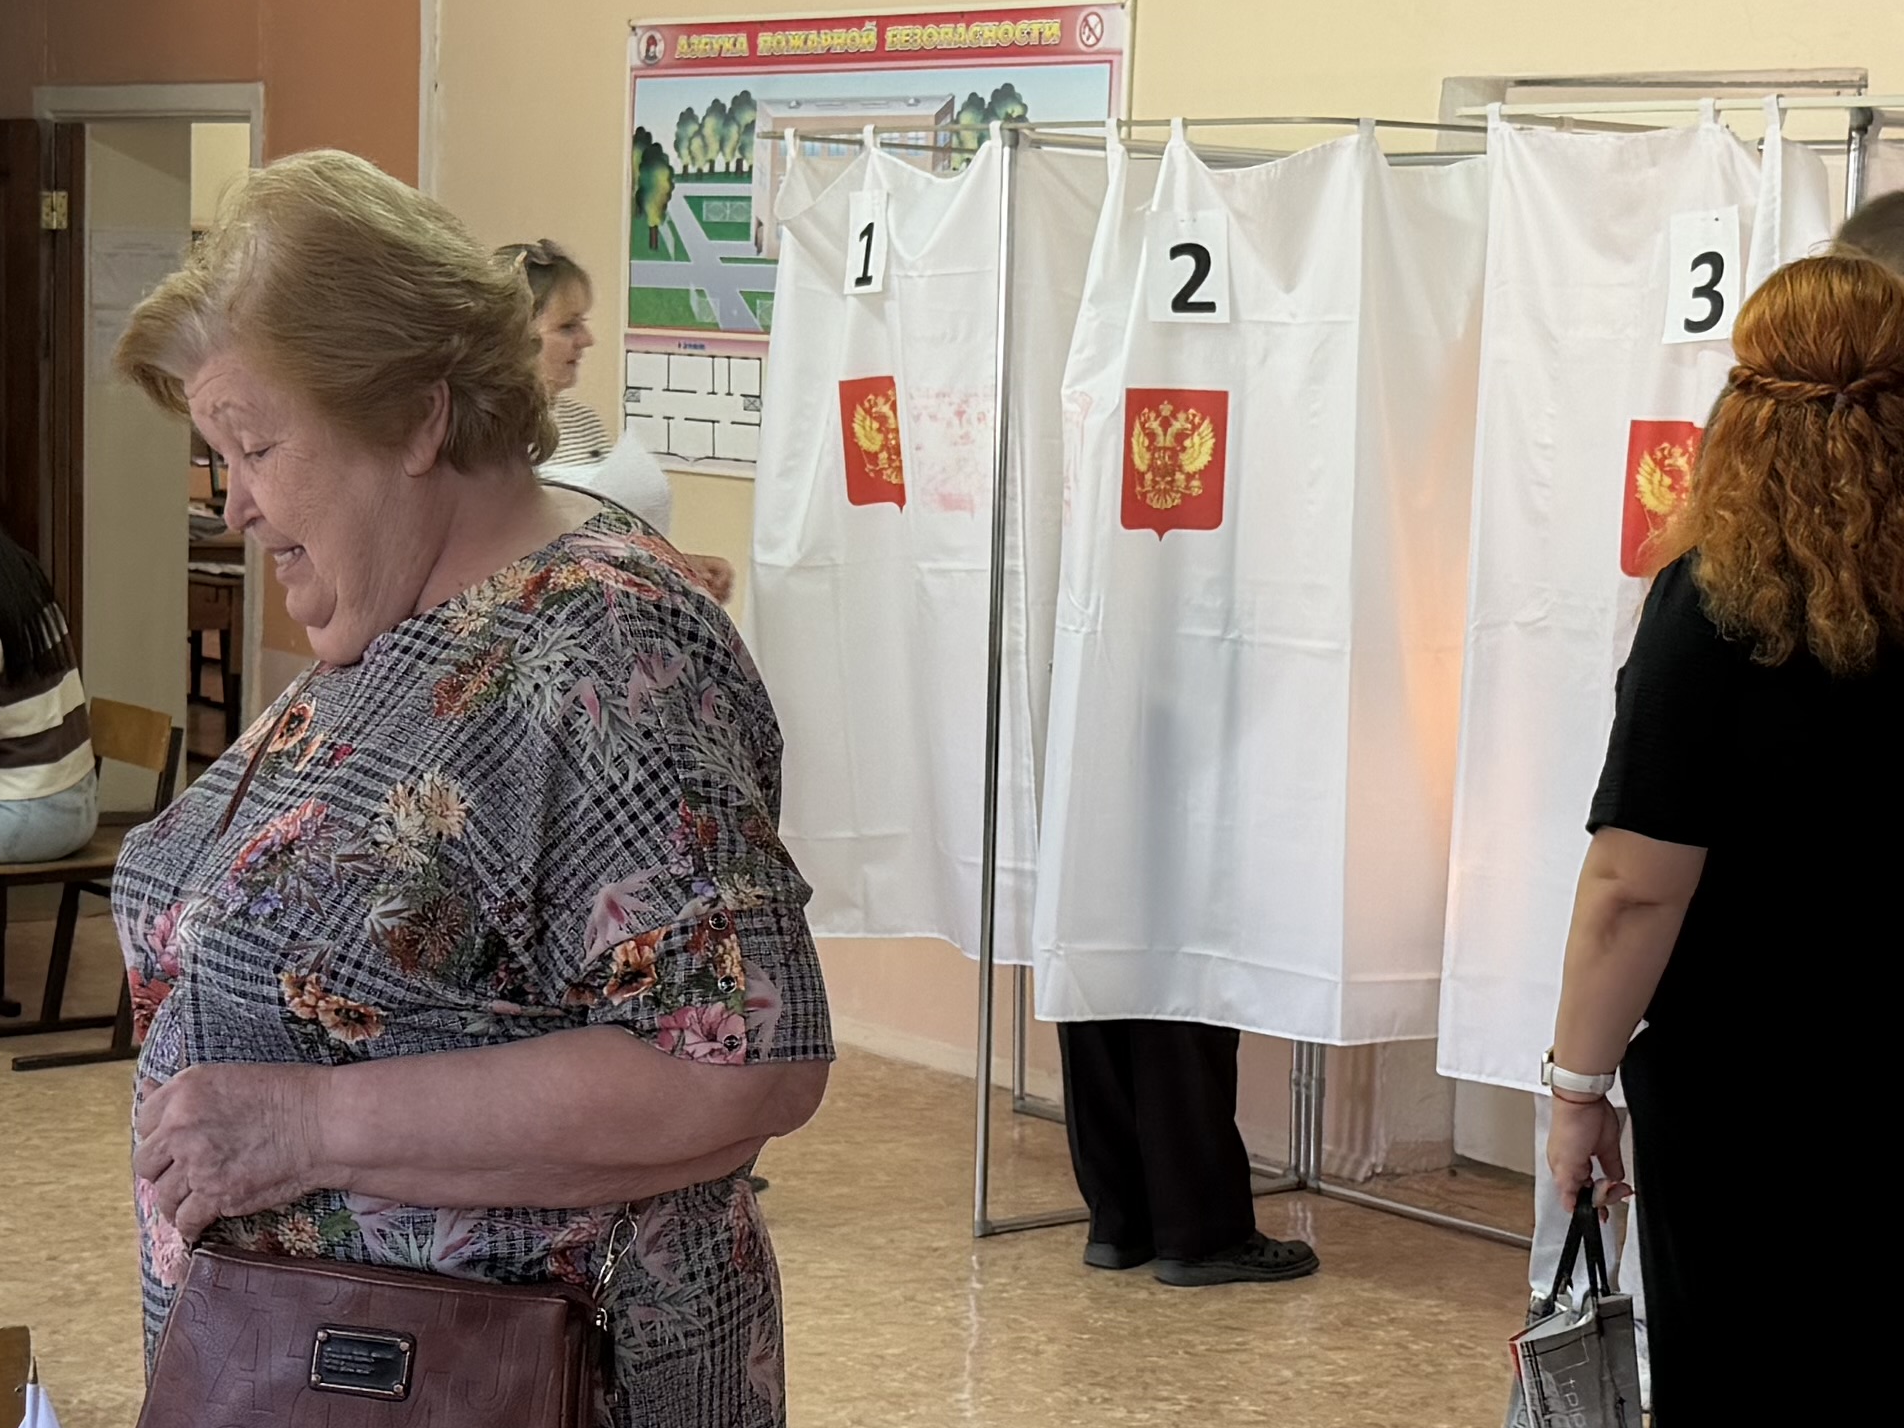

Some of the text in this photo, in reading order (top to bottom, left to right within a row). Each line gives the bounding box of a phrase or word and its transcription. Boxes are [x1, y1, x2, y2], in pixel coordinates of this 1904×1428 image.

[674, 19, 1062, 59] АЗБУКА ПОЖАРНОЙ БЕЗОПАСНОСТИ
[854, 221, 875, 288] 1
[1169, 242, 1217, 313] 2
[1683, 251, 1725, 333] 3
